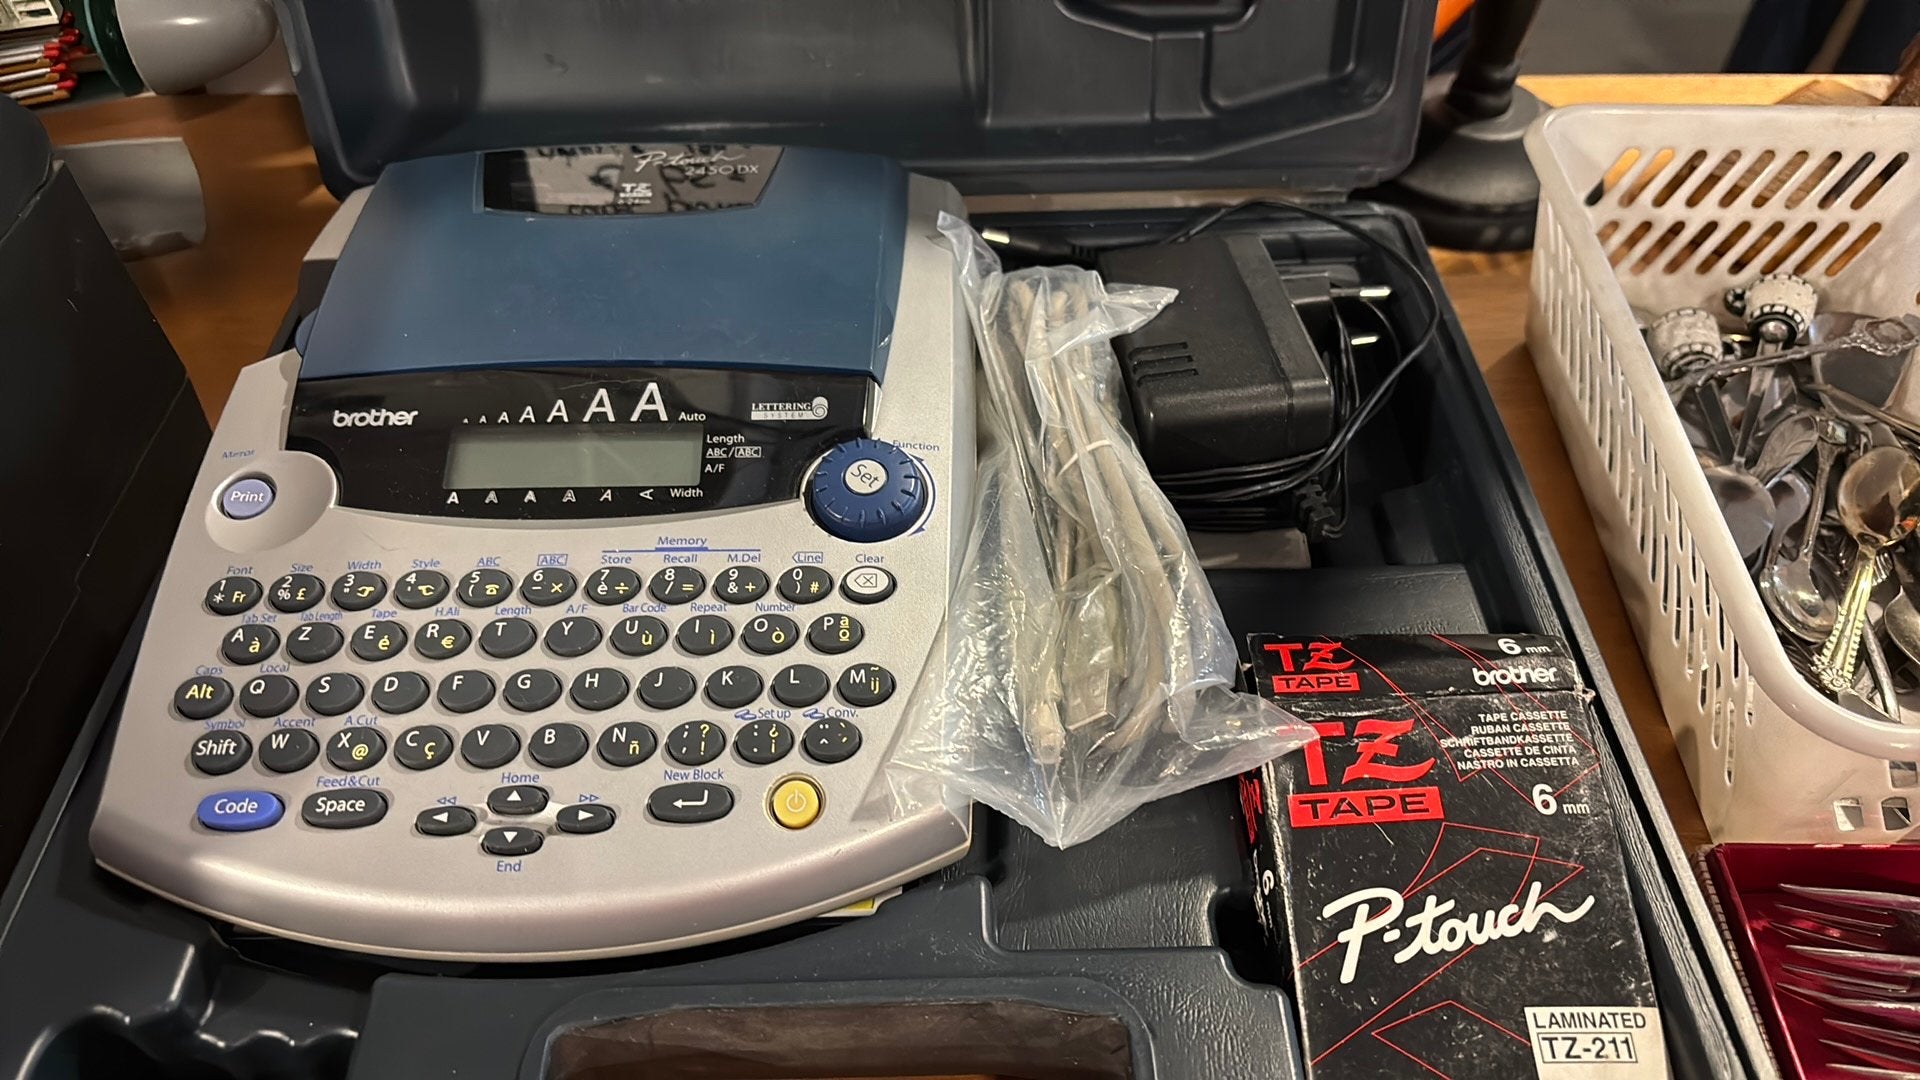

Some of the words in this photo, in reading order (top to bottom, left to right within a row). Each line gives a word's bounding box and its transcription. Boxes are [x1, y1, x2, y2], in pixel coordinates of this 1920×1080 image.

[685, 165, 734, 176] 2450
[737, 164, 759, 174] DX
[479, 415, 487, 424] A
[498, 411, 510, 424] A
[519, 406, 536, 424] A
[547, 399, 569, 423] A
[583, 388, 616, 423] A
[630, 382, 669, 422] A
[678, 412, 706, 422] Auto
[752, 402, 811, 411] LETTERING
[333, 408, 418, 428] brother
[706, 434, 745, 445] Length
[893, 440, 940, 451] Function
[704, 463, 725, 474] A/F
[851, 464, 879, 488] Set
[230, 490, 264, 503] Print
[446, 491, 460, 504] A
[485, 490, 498, 504] A
[524, 490, 537, 503] A
[562, 489, 576, 503] A
[600, 489, 612, 502] A
[670, 488, 703, 499] Width
[657, 537, 708, 547] Memory
[347, 560, 382, 570] Width
[412, 559, 440, 569] Style
[477, 557, 501, 567] ABC
[541, 556, 566, 565] ABC
[601, 554, 632, 564] Store
[663, 554, 698, 563] Recall
[727, 554, 761, 563] M.Del
[798, 554, 821, 563] Line
[855, 554, 884, 563] Clear
[227, 566, 253, 575] Font
[291, 563, 313, 572] Size
[729, 568, 739, 580] 9
[344, 574, 355, 587] 3
[406, 573, 416, 584] 4
[470, 571, 481, 583] 5
[533, 570, 543, 582] 6
[601, 569, 610, 581] 7
[664, 568, 675, 581] 8
[220, 580, 226, 591] 1
[281, 576, 293, 588] 2
[727, 581, 739, 594] &
[232, 591, 246, 603] Fr
[277, 589, 291, 600] %
[296, 588, 307, 600] £
[372, 609, 397, 619] Tape
[495, 605, 531, 617] Length
[566, 604, 588, 614] A/F
[623, 604, 639, 613] Bar
[641, 603, 666, 613] Code
[690, 603, 727, 613] Repeat
[755, 603, 795, 612] Number
[242, 614, 259, 623] Tab
[260, 613, 277, 623] Set
[301, 611, 313, 621] Tab
[314, 610, 343, 621] Length
[495, 622, 507, 636] T
[562, 622, 573, 636] Y
[626, 620, 639, 634] U
[754, 618, 768, 632] O
[823, 617, 834, 631] P
[231, 628, 244, 642] A
[298, 627, 312, 641] Z
[364, 625, 376, 640] E
[426, 623, 439, 638] R
[441, 636, 455, 649] €
[1497, 638, 1522, 655] 6
[1525, 644, 1550, 653] mm
[1263, 642, 1355, 671] TZ
[195, 666, 223, 676] Caps
[260, 663, 290, 673] Local
[452, 675, 464, 690] F
[517, 674, 531, 689] G
[585, 673, 599, 688] H
[654, 672, 663, 687] J
[722, 671, 734, 686] K
[790, 669, 800, 684] L
[850, 669, 865, 684] M
[1278, 676, 1352, 688] TAPE
[1472, 666, 1557, 687] brother
[250, 679, 265, 695] Q
[318, 677, 332, 693] S
[384, 677, 398, 692] D
[185, 684, 214, 699] Alt
[827, 707, 858, 718] Conv.
[1478, 713, 1507, 723] TAPE
[1510, 710, 1569, 721] CASSETTE
[204, 719, 246, 730] Symbol
[274, 717, 315, 727] Accent
[344, 715, 378, 725] A.Cut
[700, 724, 710, 737] ?
[1471, 724, 1511, 735] RUBAN
[1513, 722, 1570, 733] CASSETTE
[271, 733, 290, 749] W
[406, 731, 420, 746] C
[477, 730, 490, 745] V
[544, 729, 556, 744] B
[612, 727, 627, 743] N
[629, 740, 640, 755] ñ
[1440, 733, 1574, 748] SCHRIFTBANDKASSETTE
[196, 739, 237, 756] Shift
[338, 732, 352, 748] X
[352, 744, 369, 760] @
[1278, 719, 1436, 786] TZ
[1464, 746, 1522, 758] CASSETTE
[1525, 746, 1542, 755] DE
[1544, 744, 1577, 755] CINTA
[1457, 760, 1504, 770] NASTRO
[1507, 759, 1519, 768] IN
[1520, 757, 1579, 767] CASSETTA
[501, 772, 540, 783] Home
[664, 769, 691, 781] New
[693, 769, 724, 780] Block
[316, 776, 379, 788] Feed&Cut
[1532, 783, 1557, 815] 6
[1563, 802, 1590, 814] mm
[214, 799, 258, 814] Code
[316, 798, 365, 816] Space
[1299, 793, 1431, 819] TAPE
[496, 861, 521, 873] End
[1322, 881, 1595, 985] P-touch
[1533, 1012, 1646, 1030] LAMINATED
[1543, 1037, 1633, 1060] TZ-211
